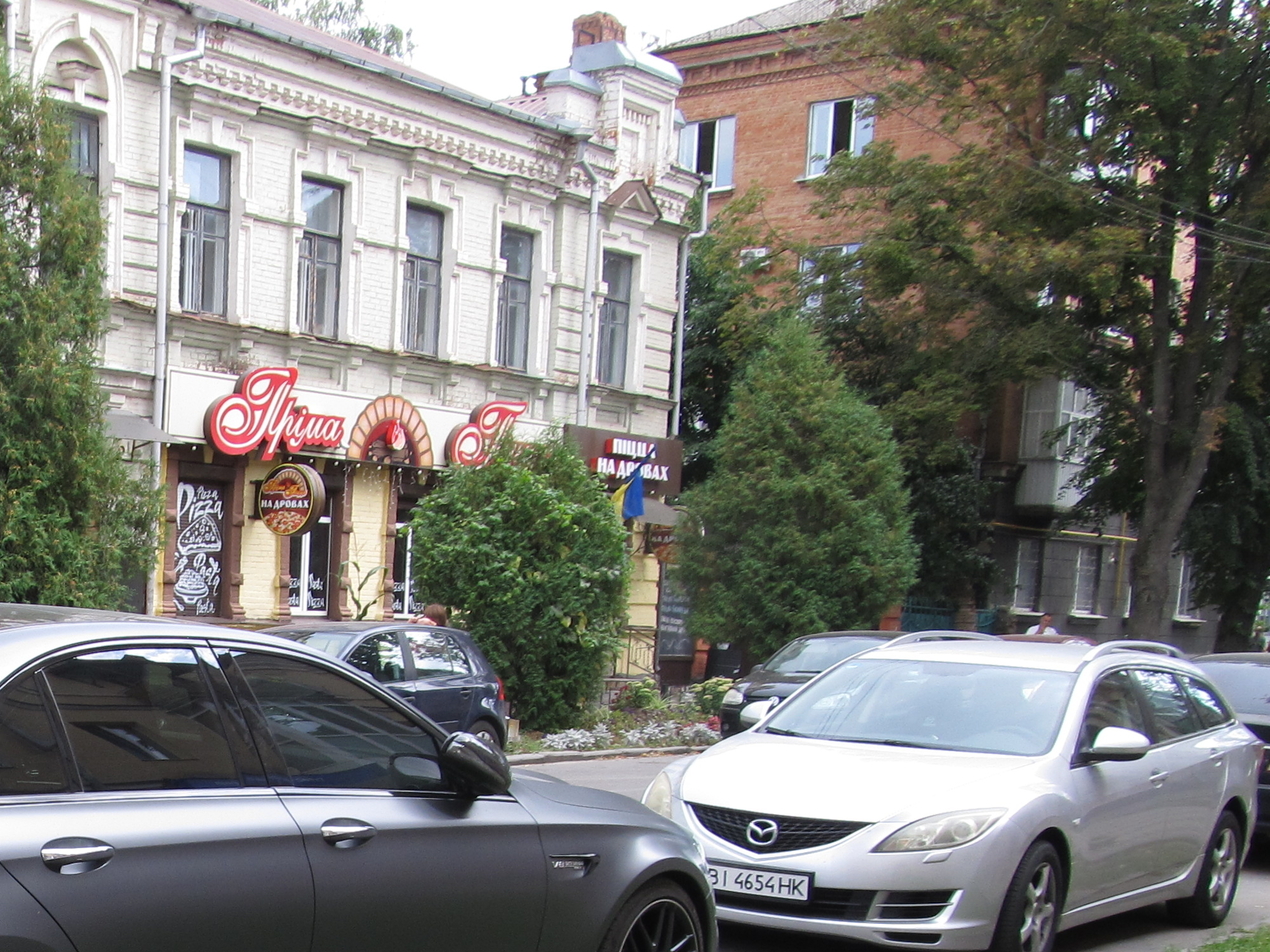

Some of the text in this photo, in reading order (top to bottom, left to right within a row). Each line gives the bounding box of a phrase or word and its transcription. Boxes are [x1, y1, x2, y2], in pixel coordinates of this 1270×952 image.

[597, 457, 616, 475] НА
[177, 482, 223, 530] Pizza
[261, 499, 310, 510] НА ДРОВАХ
[734, 872, 775, 893] 4654
[778, 877, 805, 897] HK
